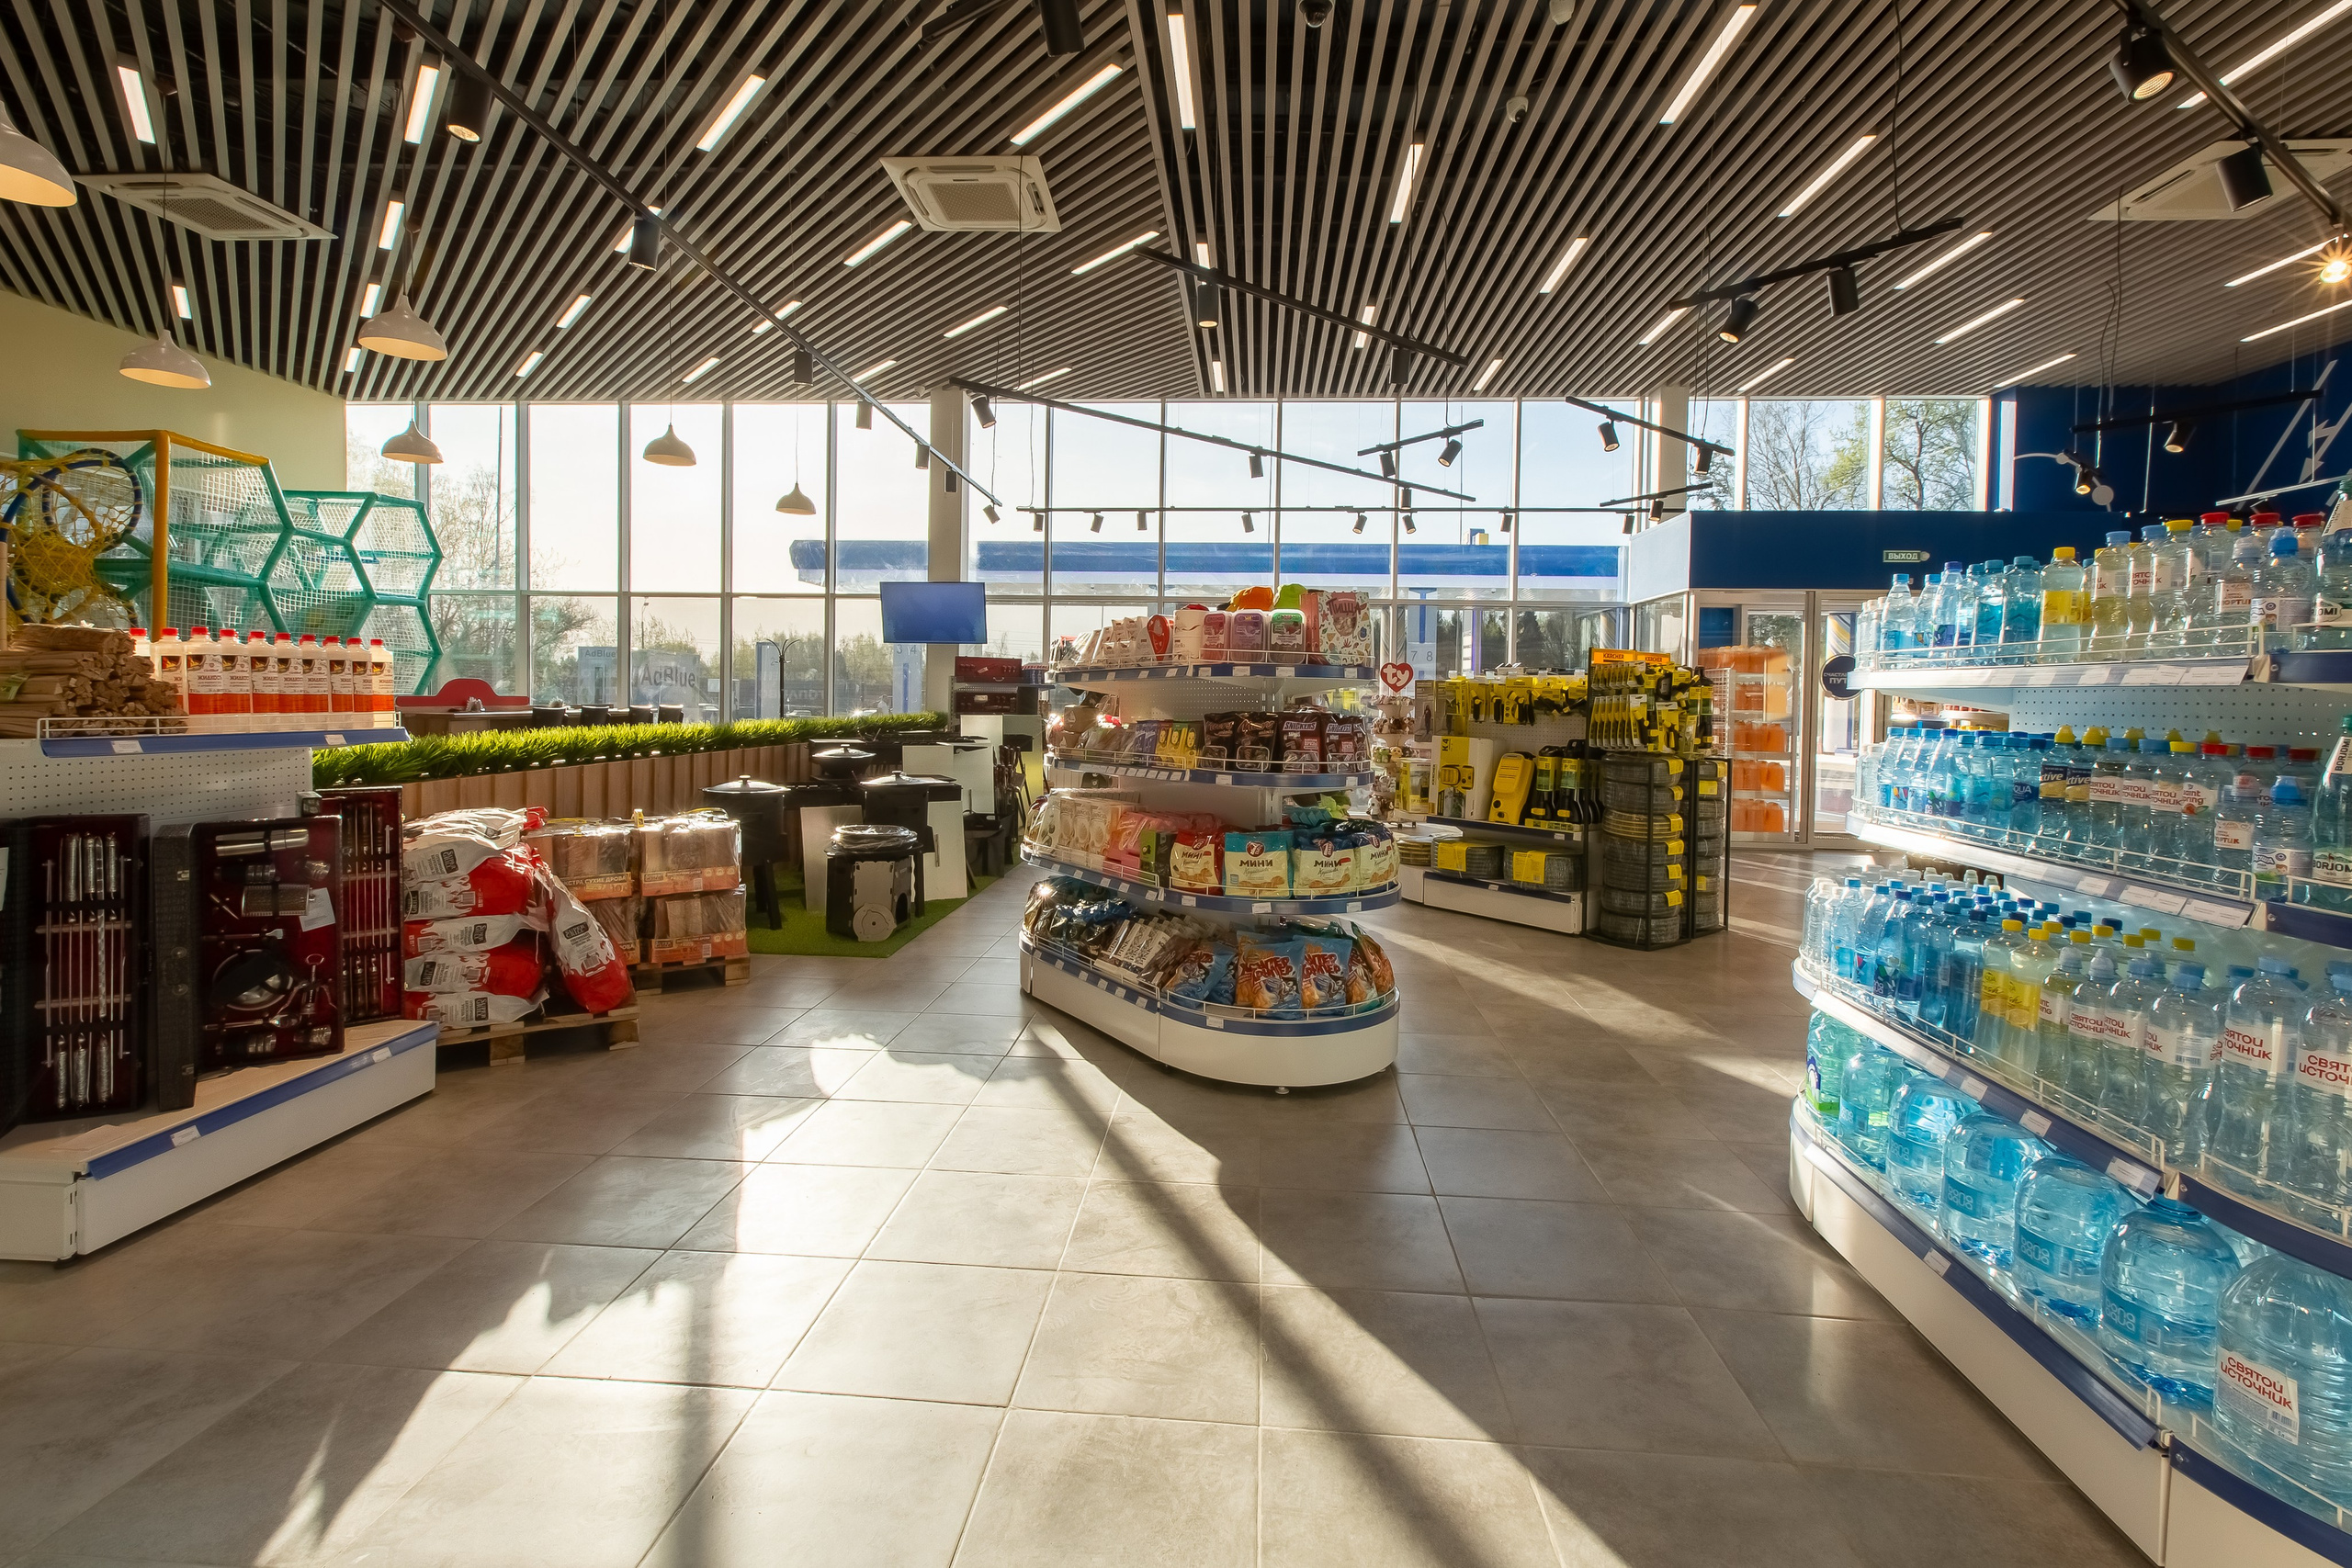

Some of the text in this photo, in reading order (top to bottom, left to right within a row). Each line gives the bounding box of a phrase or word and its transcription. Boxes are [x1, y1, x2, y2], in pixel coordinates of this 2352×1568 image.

[584, 649, 616, 658] AdBlue
[1410, 650, 1418, 661] 7
[1427, 650, 1433, 661] 8
[640, 663, 695, 688] AdBlue
[1283, 722, 1317, 730] SNICKERS
[2335, 739, 2351, 772] BORJOMI
[2225, 1027, 2264, 1047] ВЯТОЙ
[2224, 1038, 2272, 1061] ТОЧНИК
[2228, 1357, 2283, 1394] СВЯТОЙ
[2221, 1361, 2293, 1412] ИСТОЧНИК
